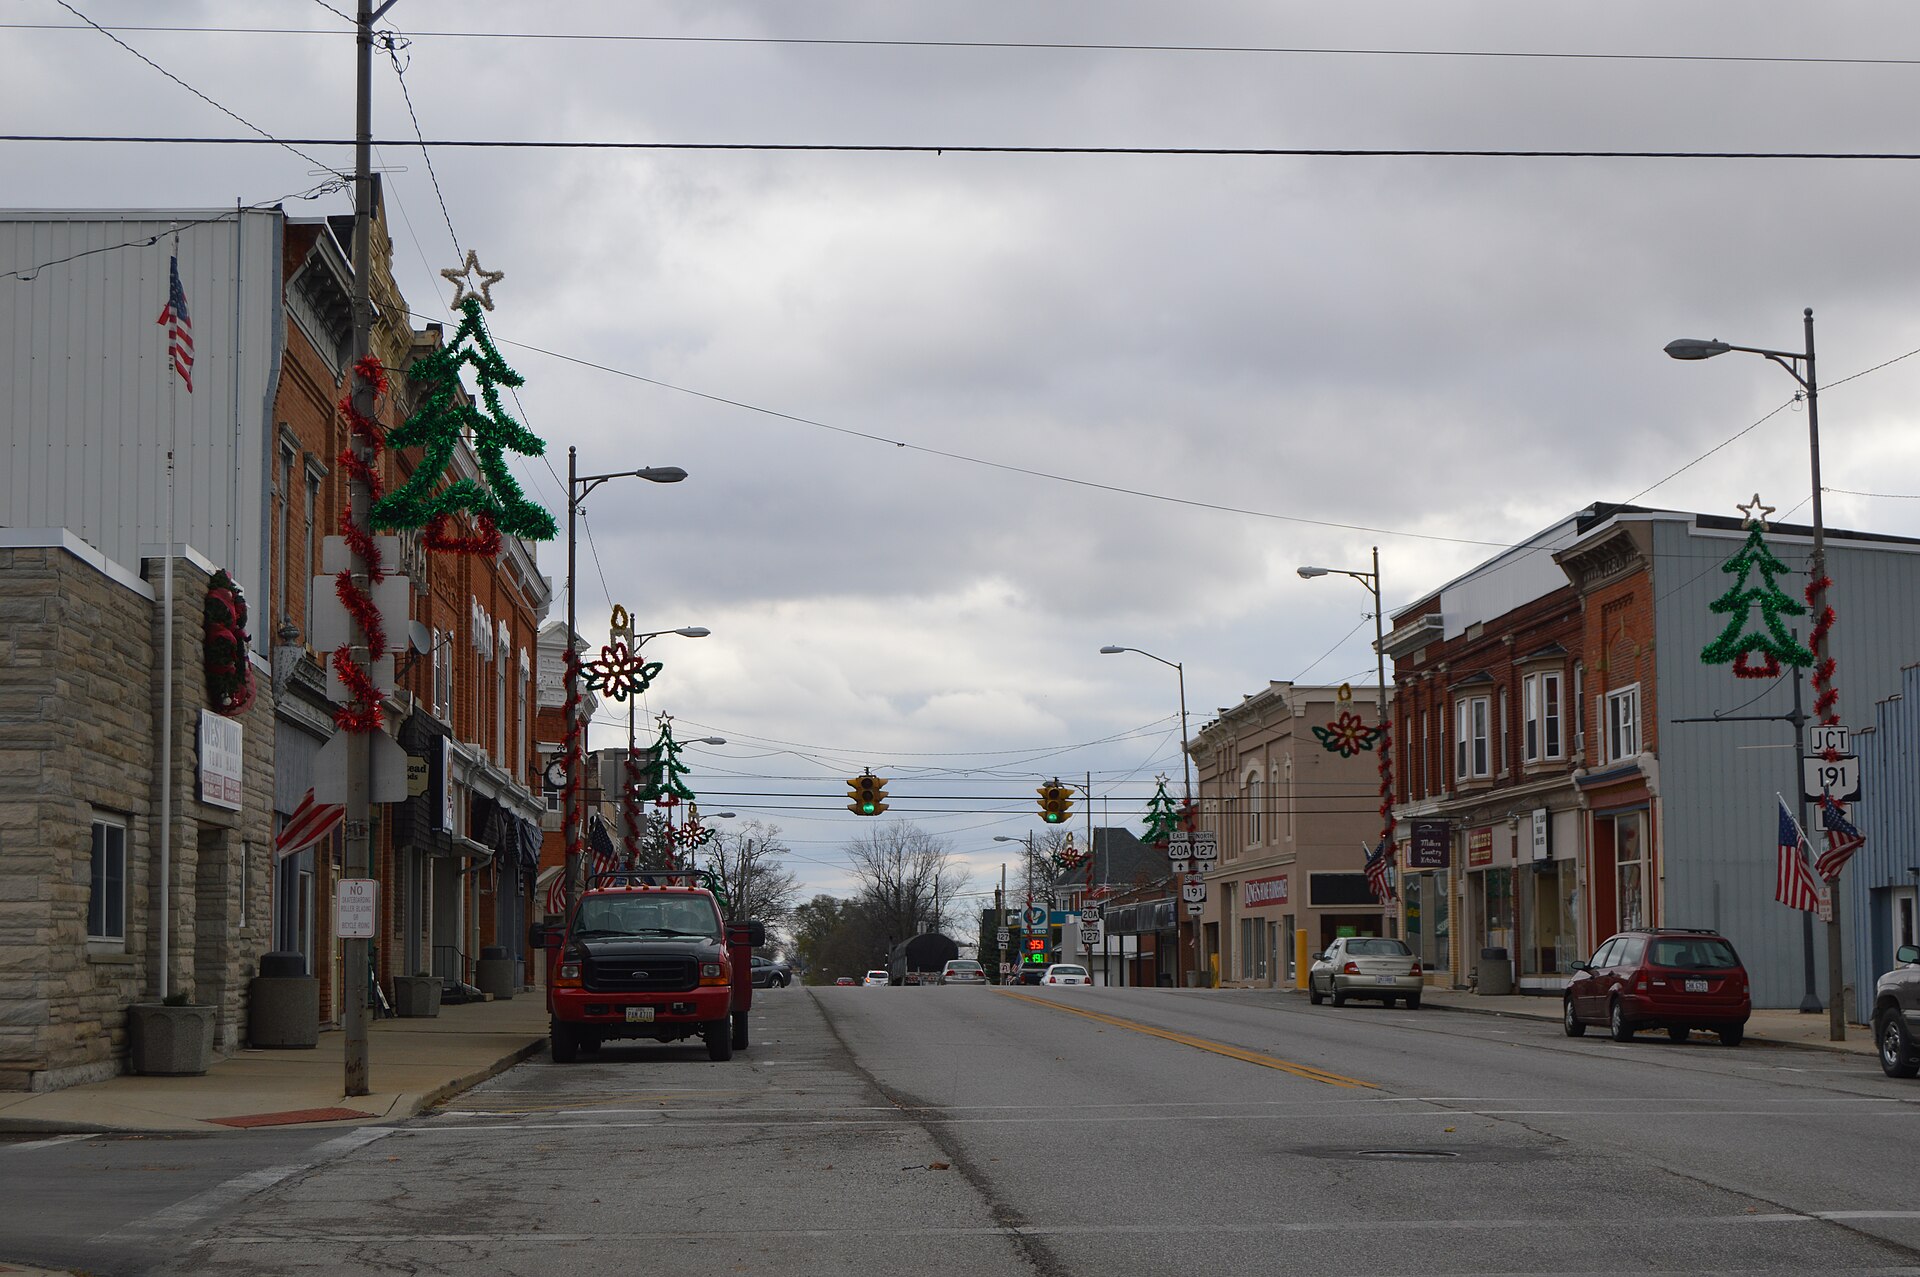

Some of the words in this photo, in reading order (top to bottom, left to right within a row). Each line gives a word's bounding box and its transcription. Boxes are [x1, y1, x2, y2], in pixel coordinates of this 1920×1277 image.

[203, 713, 222, 749] WEST
[1813, 731, 1847, 749] JCT
[1817, 766, 1846, 787] 191
[1170, 845, 1189, 856] 20A
[1195, 845, 1214, 856] 127
[1421, 848, 1442, 857] Country
[350, 885, 363, 896] NO
[1187, 888, 1203, 897] 191
[1083, 910, 1098, 919] 20A
[998, 933, 1009, 941] 127
[1083, 932, 1098, 941] 127
